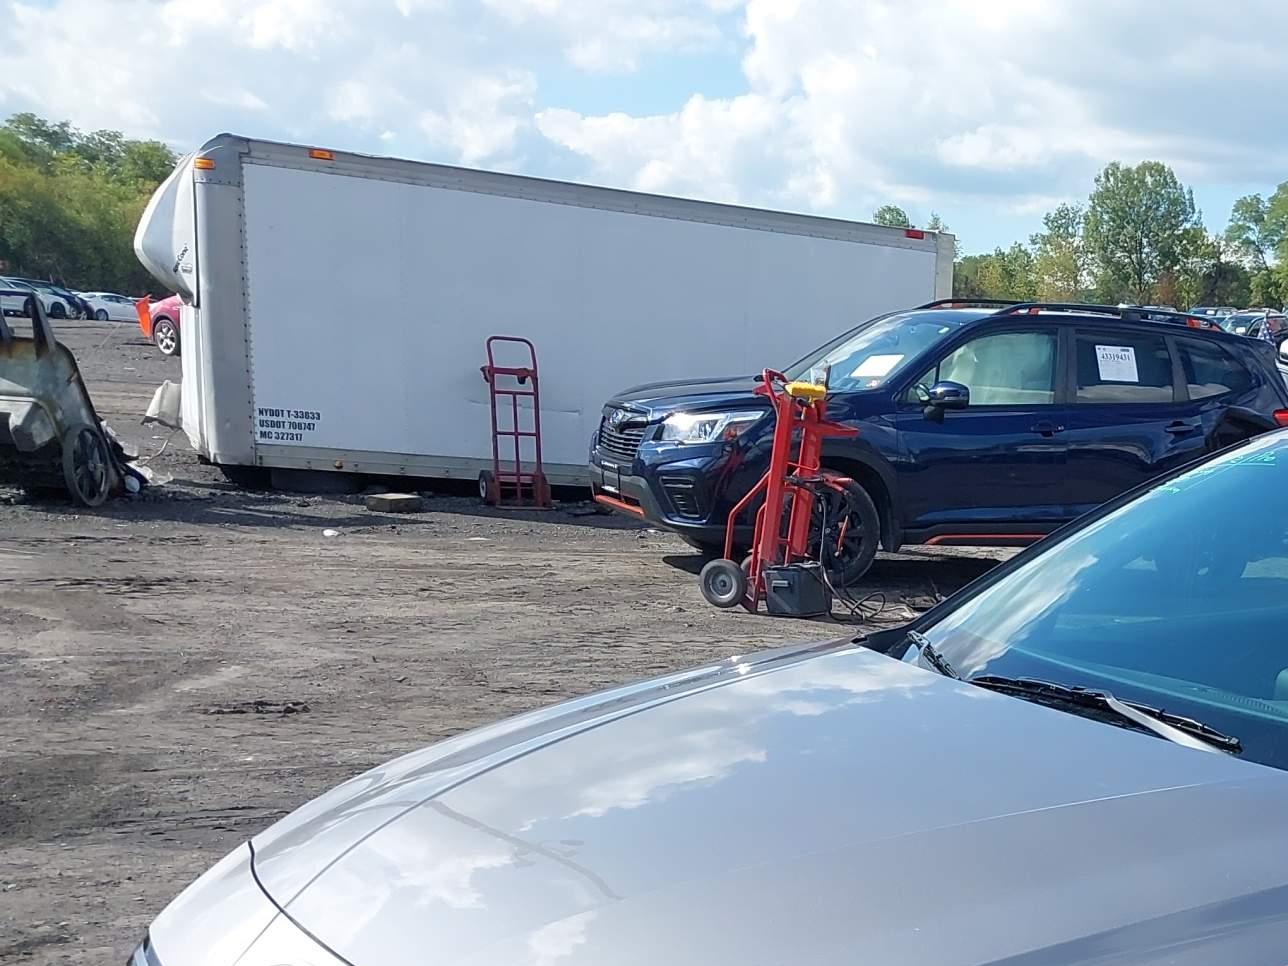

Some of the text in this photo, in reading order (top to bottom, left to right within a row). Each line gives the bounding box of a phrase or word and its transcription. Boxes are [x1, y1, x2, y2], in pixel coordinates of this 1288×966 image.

[258, 408, 285, 418] NYDOT
[259, 419, 286, 429] USDOT
[259, 431, 302, 441] MC 327317
